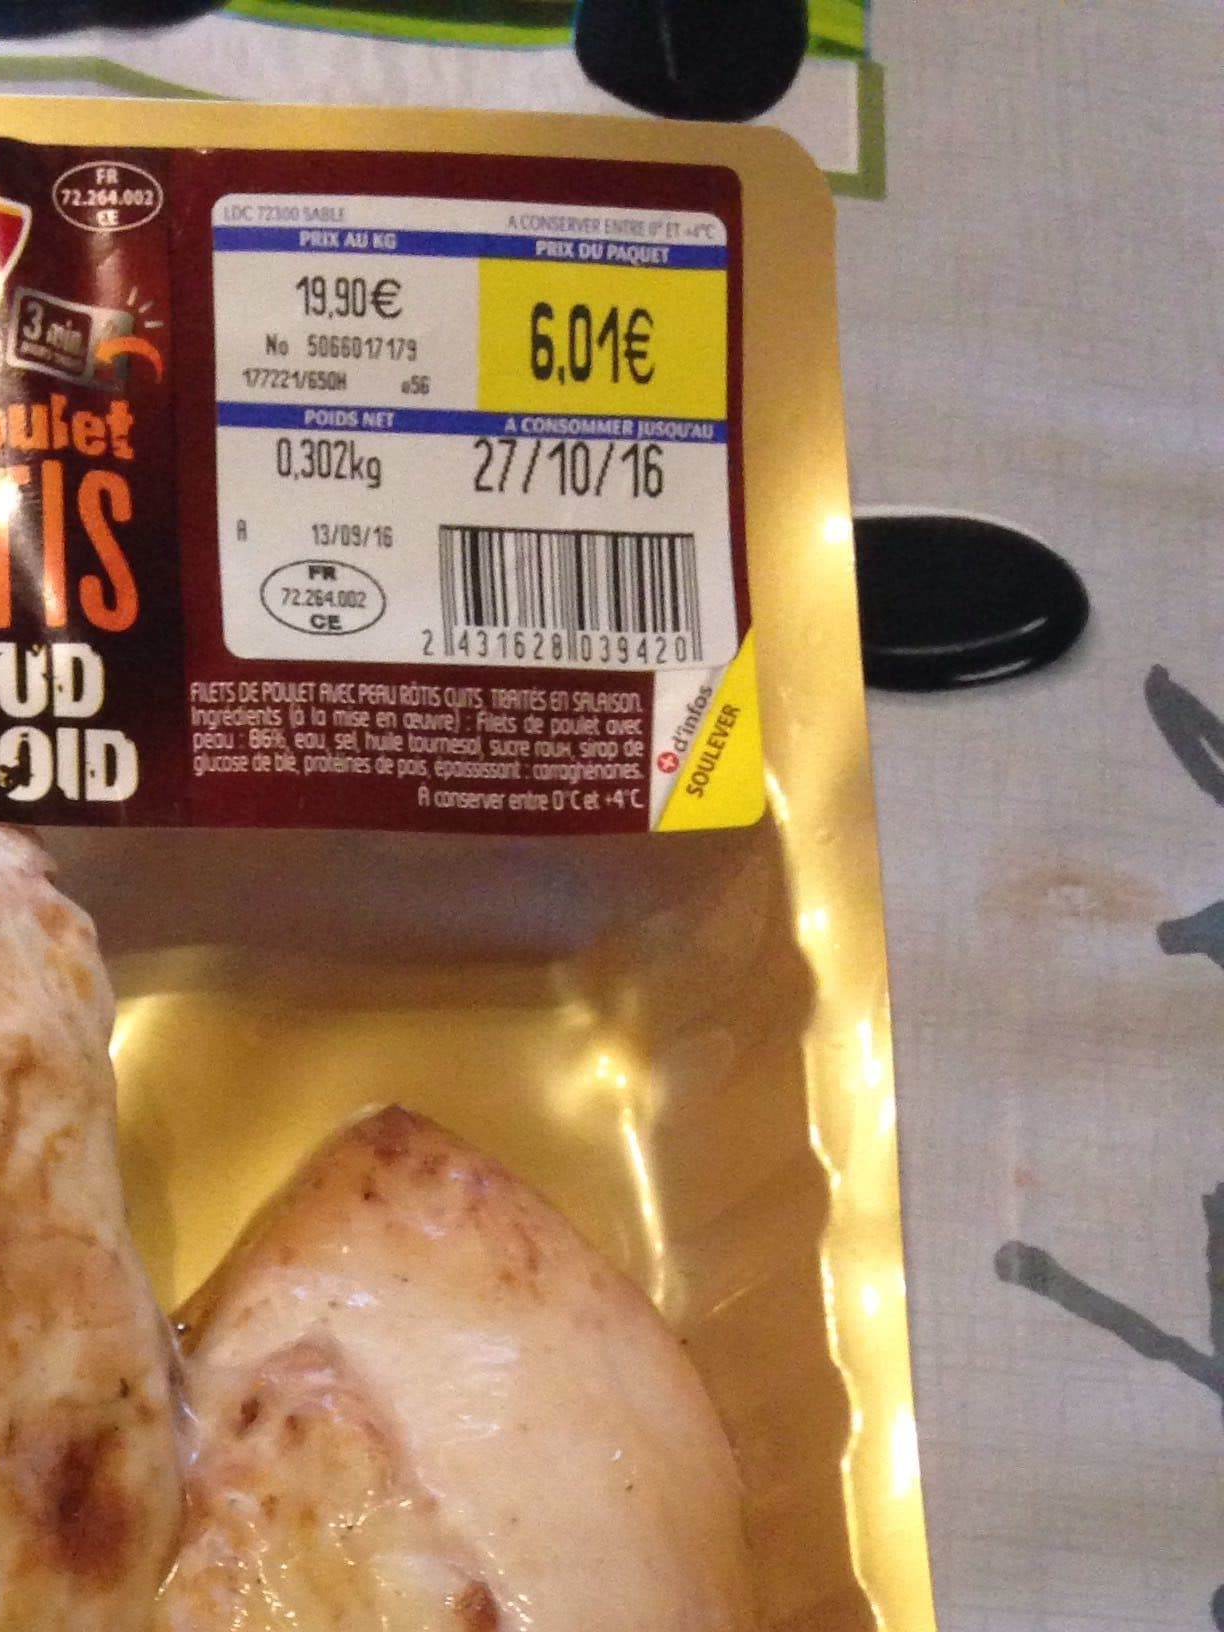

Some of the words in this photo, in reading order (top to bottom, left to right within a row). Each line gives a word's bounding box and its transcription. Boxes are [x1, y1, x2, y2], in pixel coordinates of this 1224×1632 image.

[96, 167, 118, 185] FR
[60, 188, 153, 206] 72.264.002
[96, 208, 119, 226] CE
[223, 207, 252, 222] LDC
[257, 207, 299, 222] 72300
[303, 207, 345, 222] SABLE
[508, 215, 518, 230] A
[520, 215, 602, 234] CONSERVER
[605, 219, 644, 237] ENTRE
[666, 222, 680, 238] ET
[299, 230, 340, 247] PRIX
[344, 231, 369, 248] AU
[373, 232, 398, 250] KG
[535, 240, 576, 258] PRIX
[579, 242, 603, 260] DU
[606, 244, 670, 266] PAQUET
[22, 300, 43, 341] 3
[265, 334, 289, 356] No
[307, 335, 417, 361] 5066017179
[530, 302, 656, 386] 6,01€
[304, 410, 358, 428] POIDS
[362, 412, 395, 428] NET
[504, 418, 517, 432] A
[521, 419, 634, 436] CONSOMMER
[637, 422, 714, 440] JUSQU'AU
[276, 437, 382, 489] 0,302kg
[473, 438, 664, 498] 27/10/16
[311, 523, 393, 548] 13/09/16
[308, 565, 337, 581] FR
[281, 587, 367, 609] 72.264.002
[310, 615, 343, 631] CE
[191, 681, 236, 703] FILETS
[238, 681, 259, 703] DE
[262, 681, 316, 703] POULET
[319, 682, 356, 704] AVEC
[358, 684, 396, 705] PEAU
[399, 681, 441, 707] RÔTIS
[523, 713, 545, 734] de
[550, 714, 600, 738] poulet
[605, 718, 643, 736] avec
[675, 685, 713, 753] d'infos
[192, 732, 235, 753] peau
[489, 739, 531, 757] sucre
[623, 739, 645, 758] de
[685, 703, 742, 799] SOULEVER
[375, 755, 395, 774] de
[434, 790, 506, 809] conserver
[508, 789, 548, 811] entre
[583, 790, 600, 811] et
